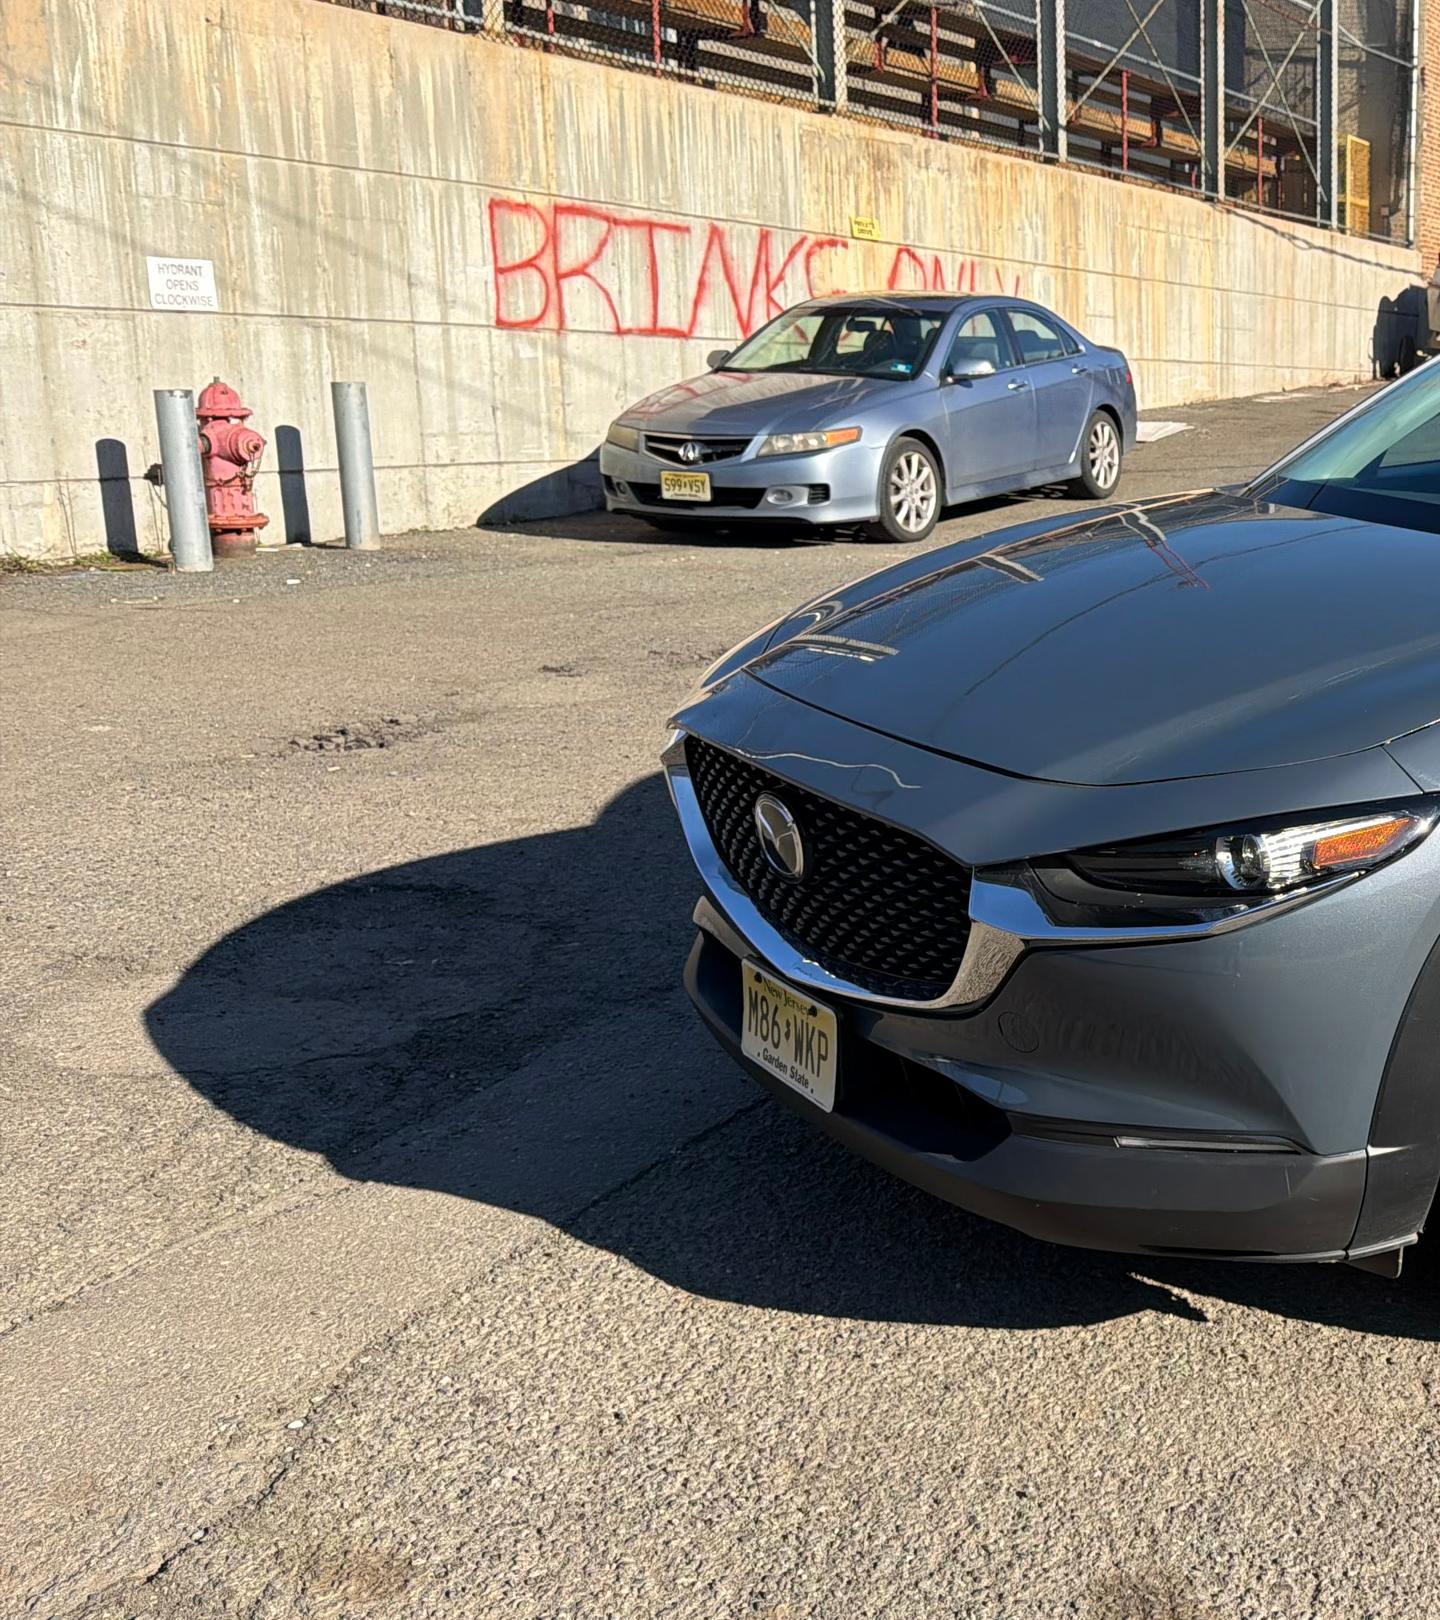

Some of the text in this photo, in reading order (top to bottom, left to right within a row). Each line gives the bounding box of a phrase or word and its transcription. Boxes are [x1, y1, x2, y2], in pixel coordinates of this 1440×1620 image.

[158, 264, 204, 276] HYDRANT
[166, 279, 199, 291] OPENS
[155, 293, 214, 306] CLOCKWISE
[763, 977, 782, 999] New
[762, 1047, 810, 1089] Garden State
